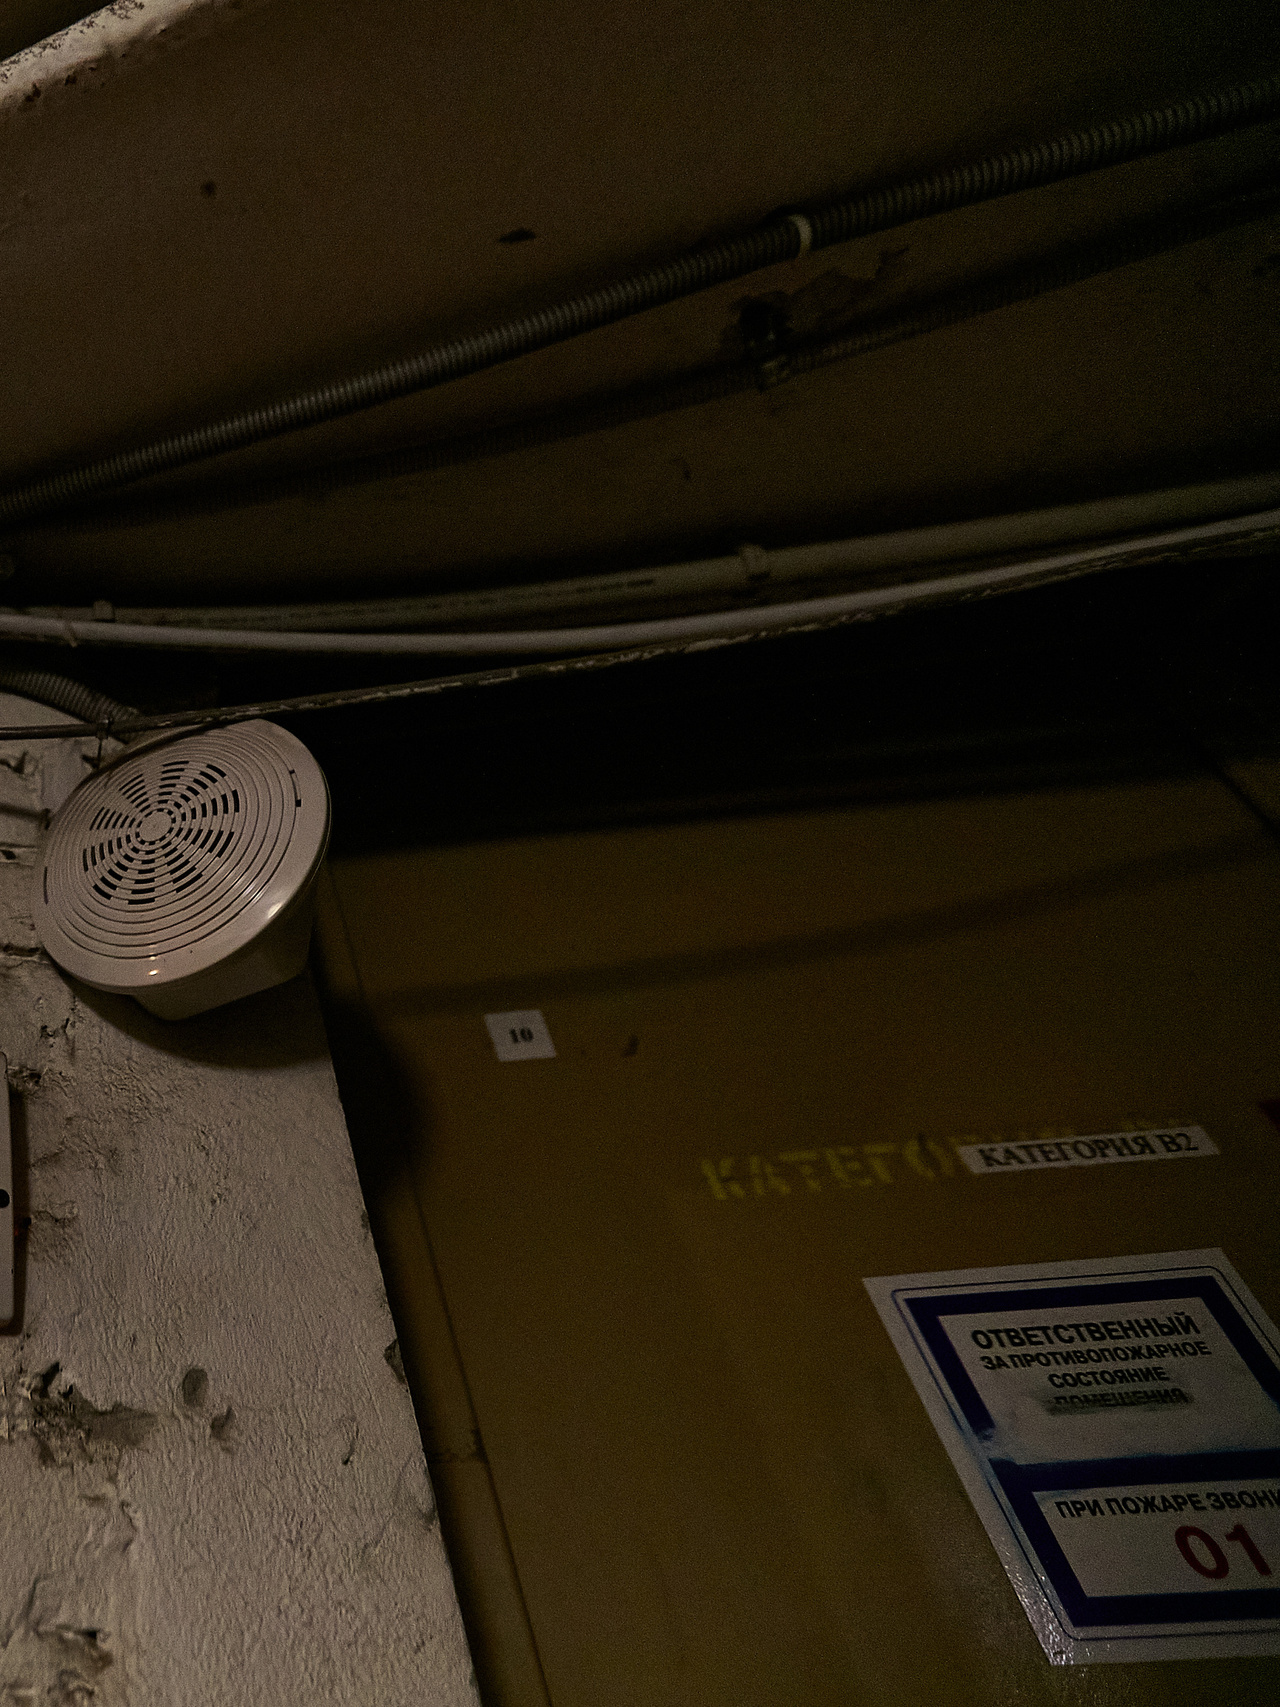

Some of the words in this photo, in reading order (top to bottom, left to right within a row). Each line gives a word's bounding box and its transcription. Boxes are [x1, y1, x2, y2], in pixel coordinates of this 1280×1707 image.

[509, 1027, 534, 1044] 10
[979, 1134, 1157, 1168] КАТЕГОРИЯ
[1156, 1131, 1199, 1153] В2
[971, 1311, 1201, 1349] ОТВЕТСТВЕННЫЙ
[980, 1355, 1009, 1371] ЗА
[1008, 1341, 1212, 1368] ПРОТИВОПОЖАРНОЕ
[1048, 1366, 1171, 1389] СОСТОЯНИЕ
[1055, 1500, 1105, 1518] ПРИ
[1105, 1493, 1207, 1516] ПОЖАРЕ
[1174, 1524, 1272, 1580] 01
